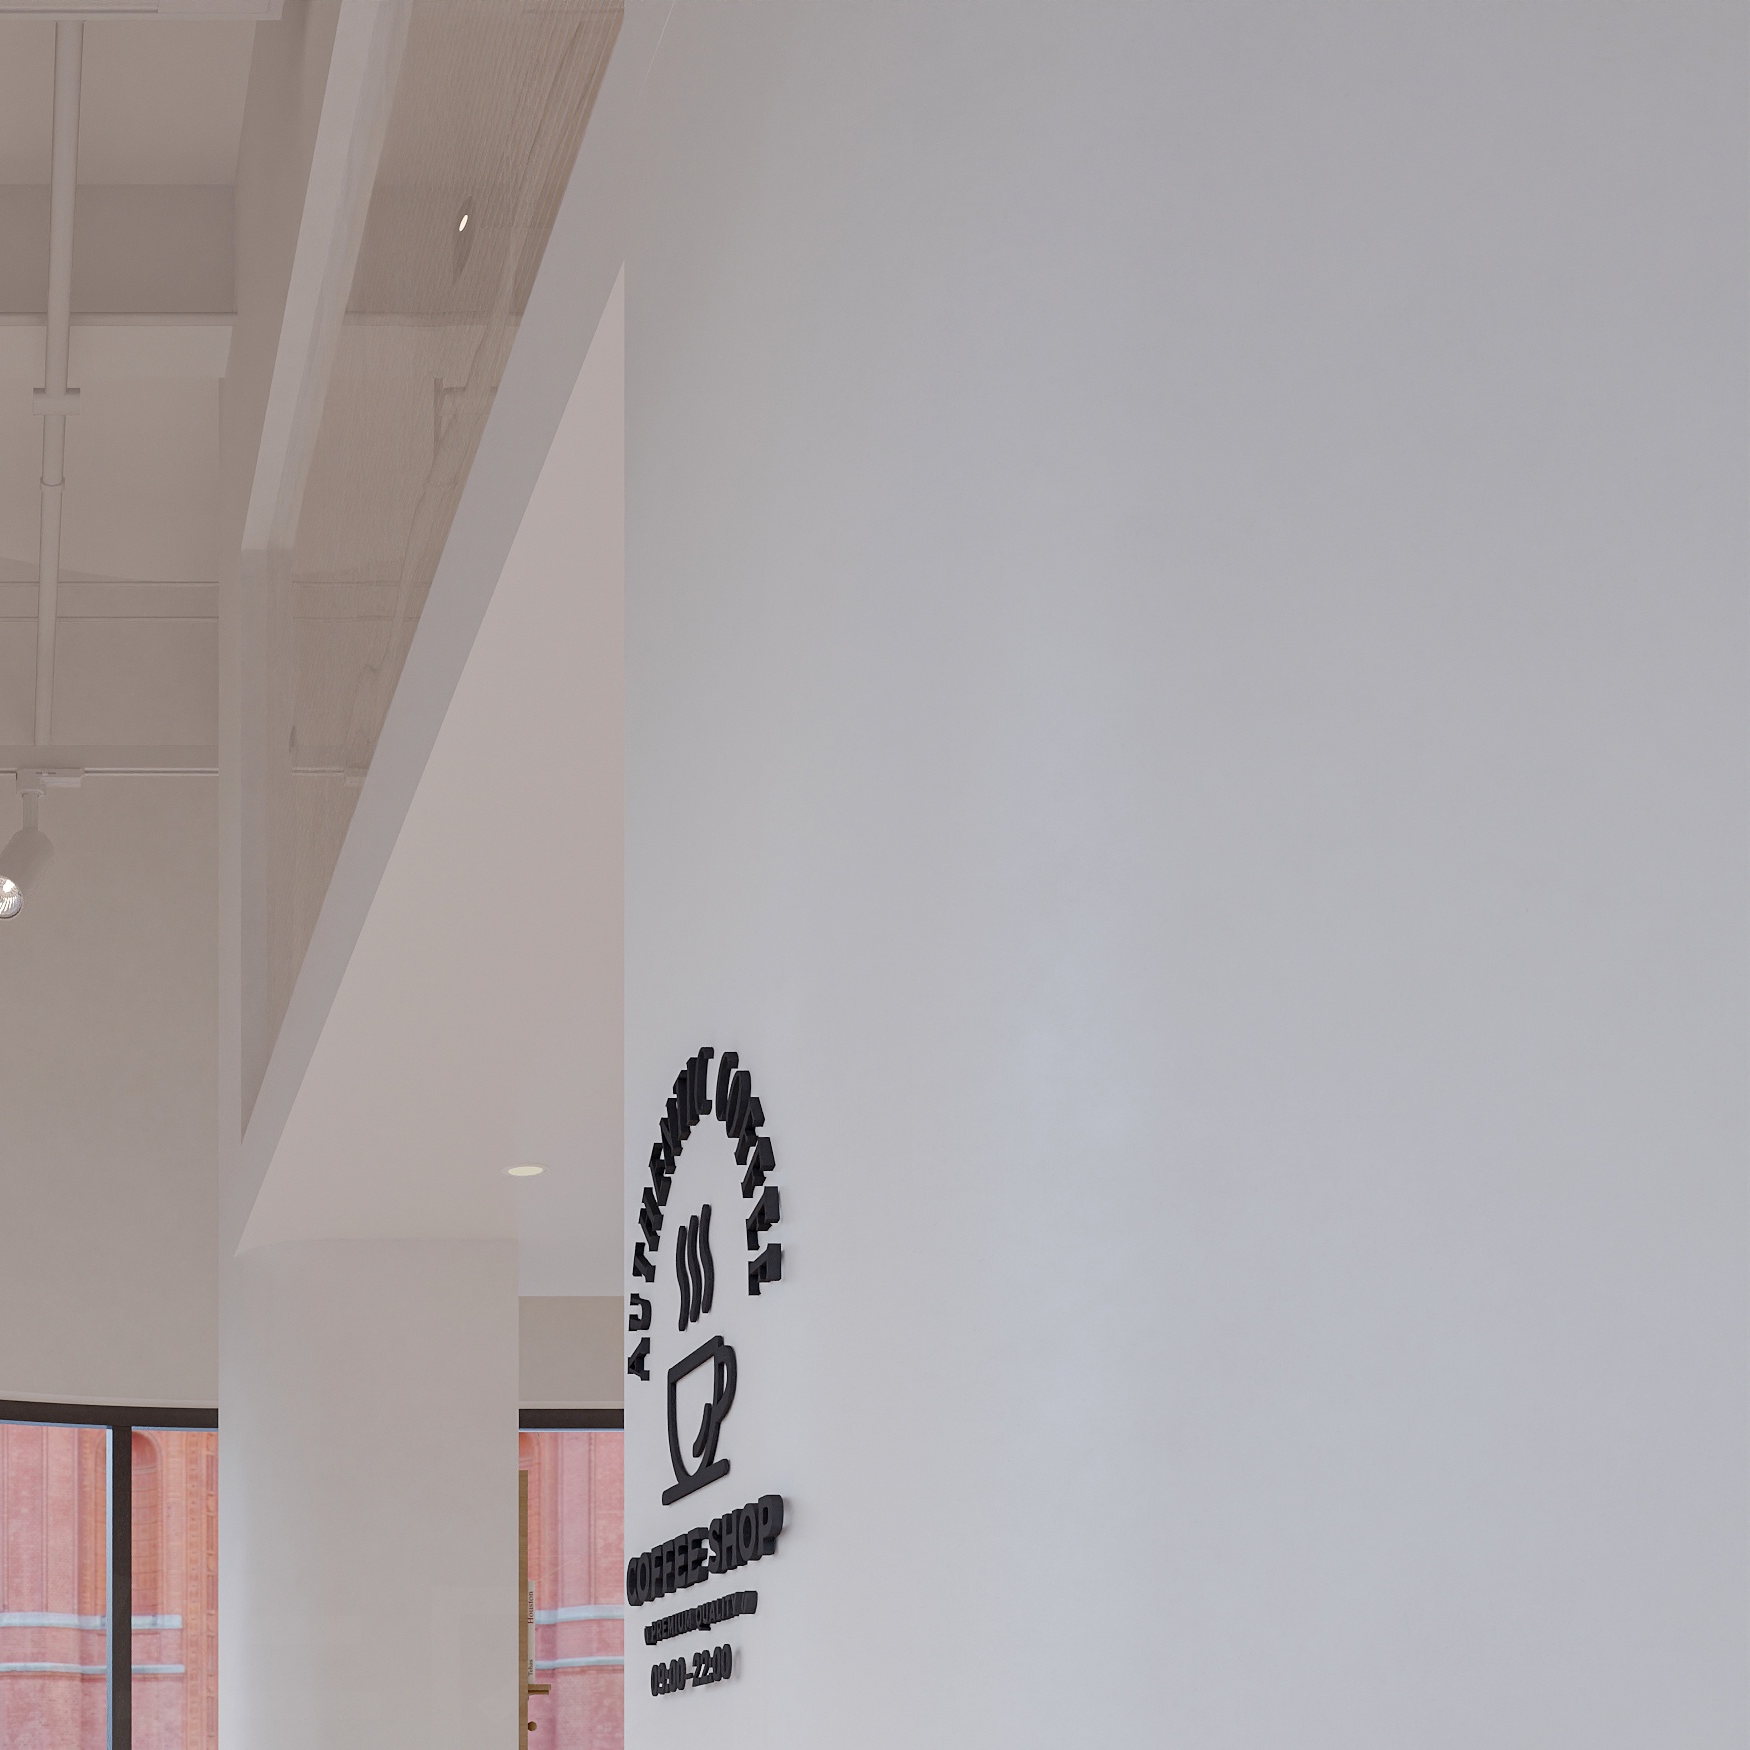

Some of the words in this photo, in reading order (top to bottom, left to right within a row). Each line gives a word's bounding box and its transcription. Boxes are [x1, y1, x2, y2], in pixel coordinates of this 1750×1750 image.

[628, 1047, 714, 1381] AUTHENTIC
[715, 1051, 782, 1295] COFFEE
[627, 1527, 709, 1606] COFFEE
[708, 1494, 784, 1574] SHOP
